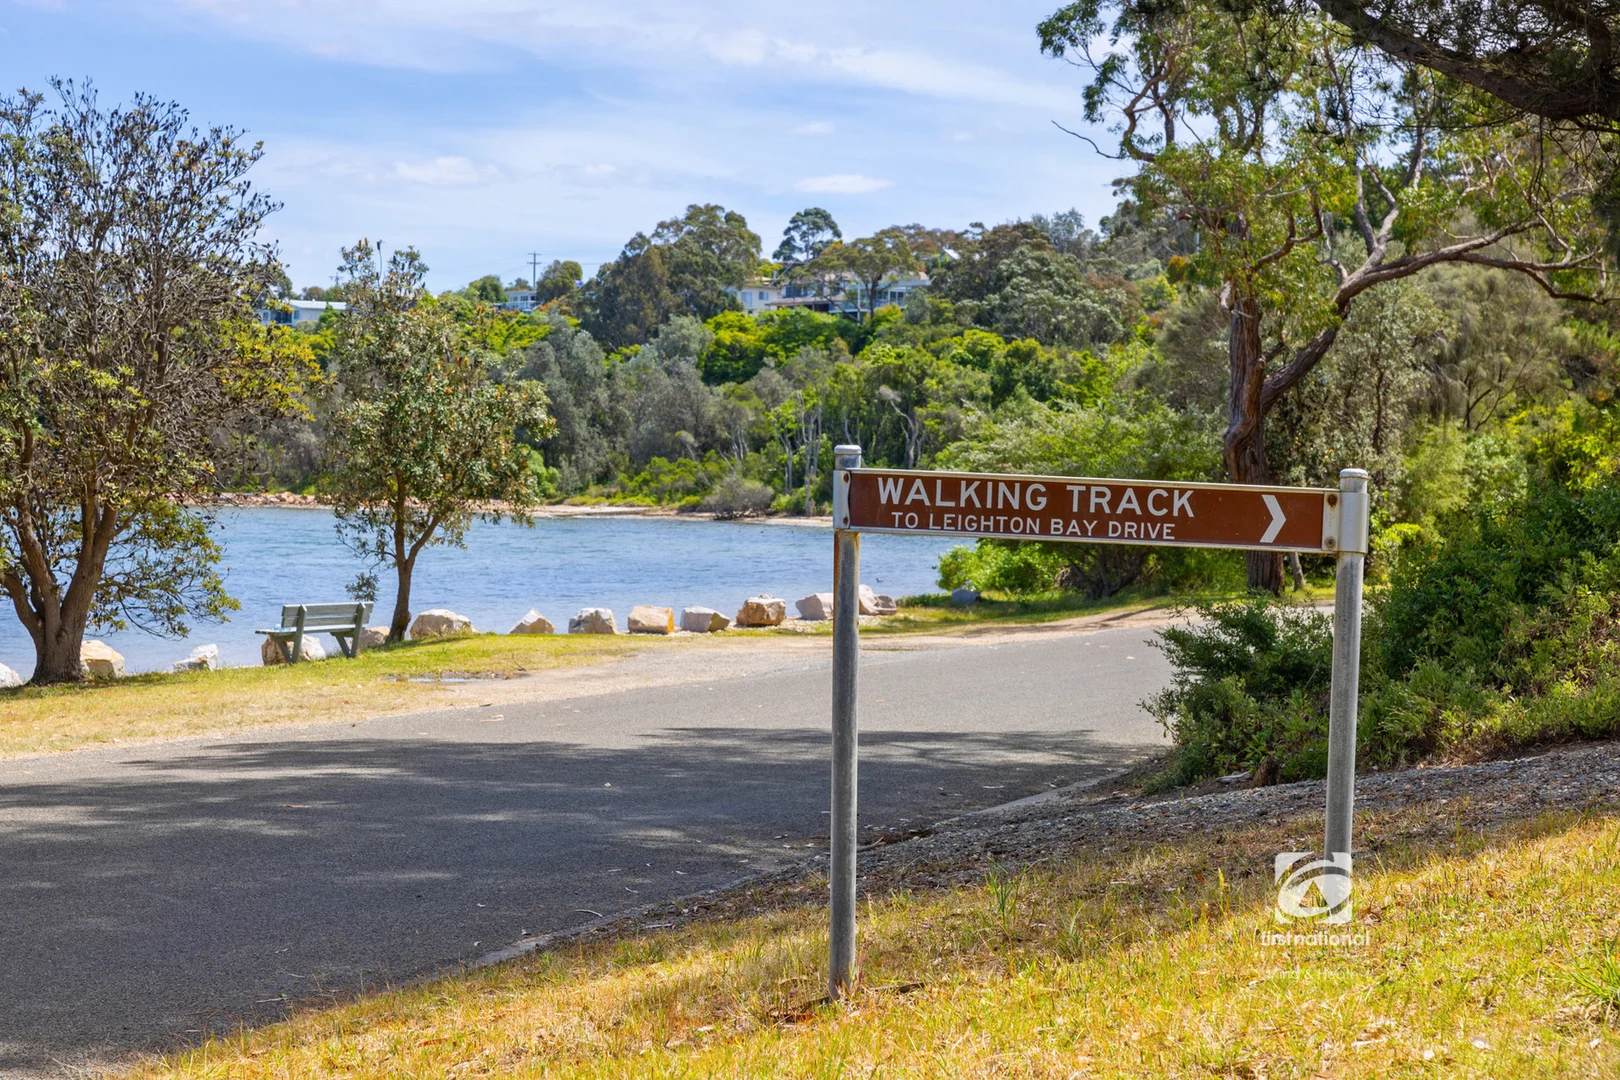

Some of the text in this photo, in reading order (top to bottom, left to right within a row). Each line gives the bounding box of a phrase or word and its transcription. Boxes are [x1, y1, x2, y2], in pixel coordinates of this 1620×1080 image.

[877, 477, 1195, 518] WALKING TRACK
[891, 511, 1176, 540] TO LEIGHTON BAY DRIVE
